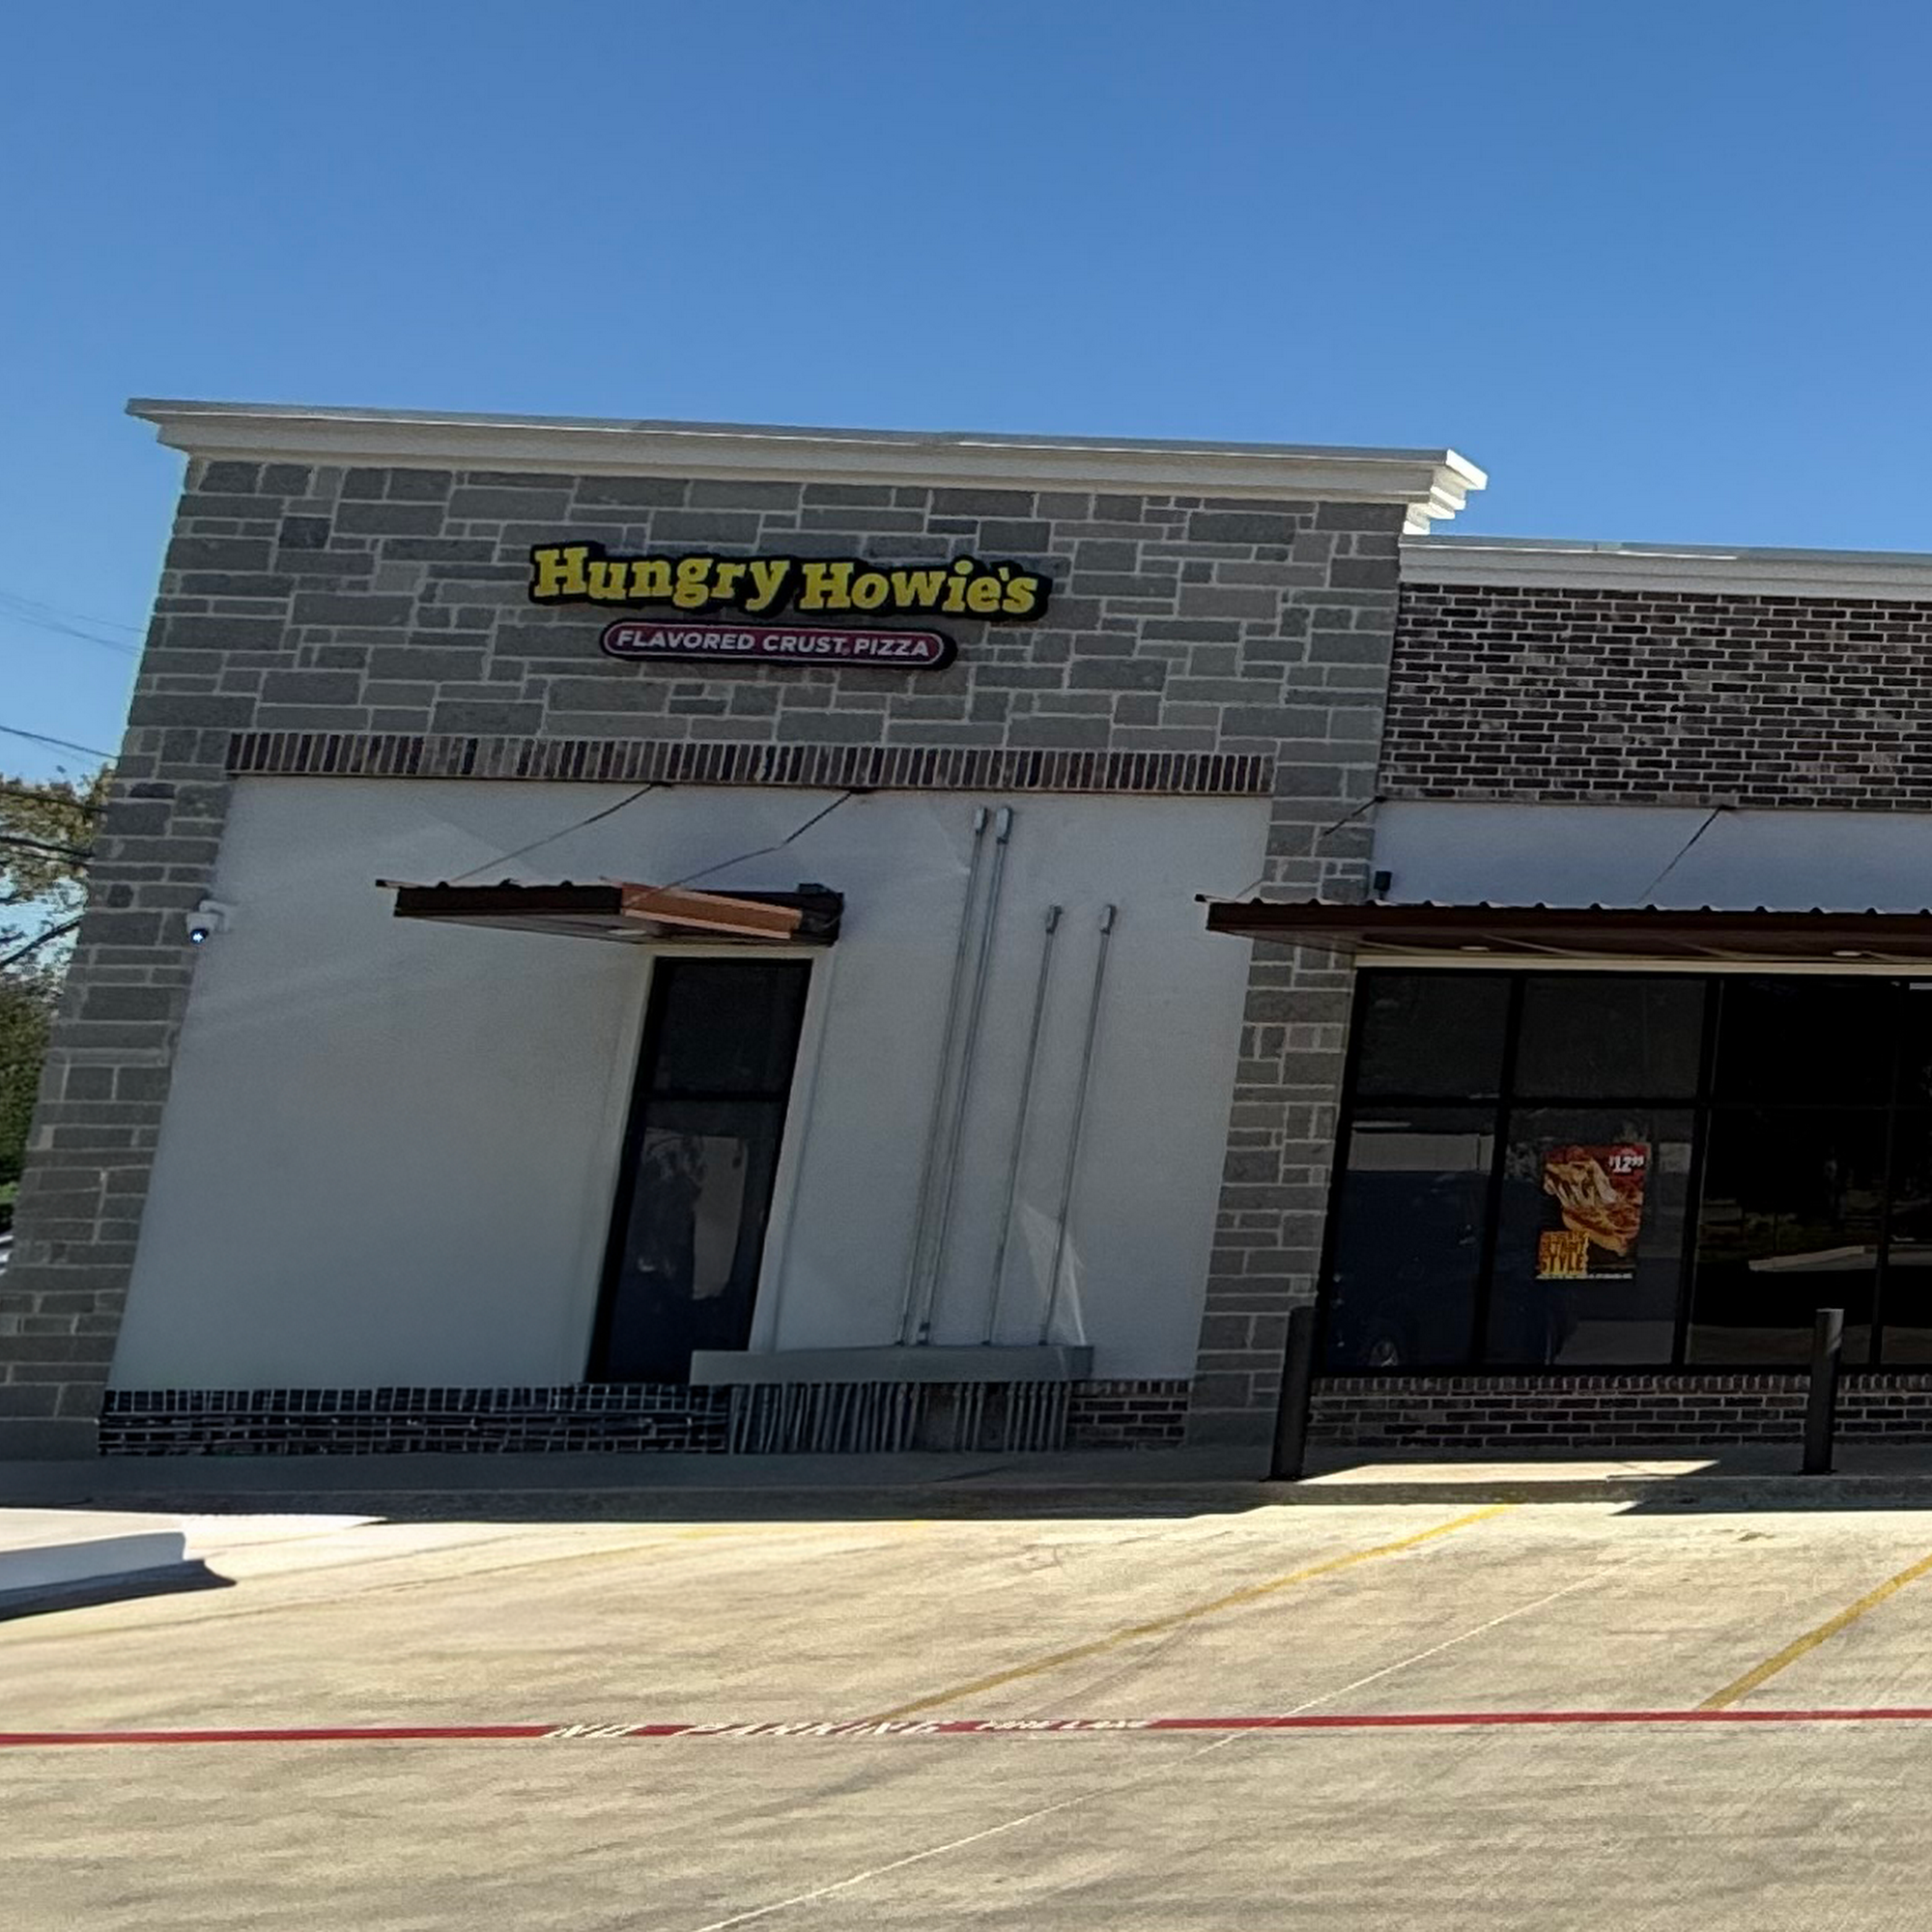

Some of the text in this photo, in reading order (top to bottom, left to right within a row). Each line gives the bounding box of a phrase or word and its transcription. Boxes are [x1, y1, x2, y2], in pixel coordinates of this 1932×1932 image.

[533, 547, 1038, 613] Hungry Howie's
[616, 631, 929, 657] FLAVORED CRUST PIZZA
